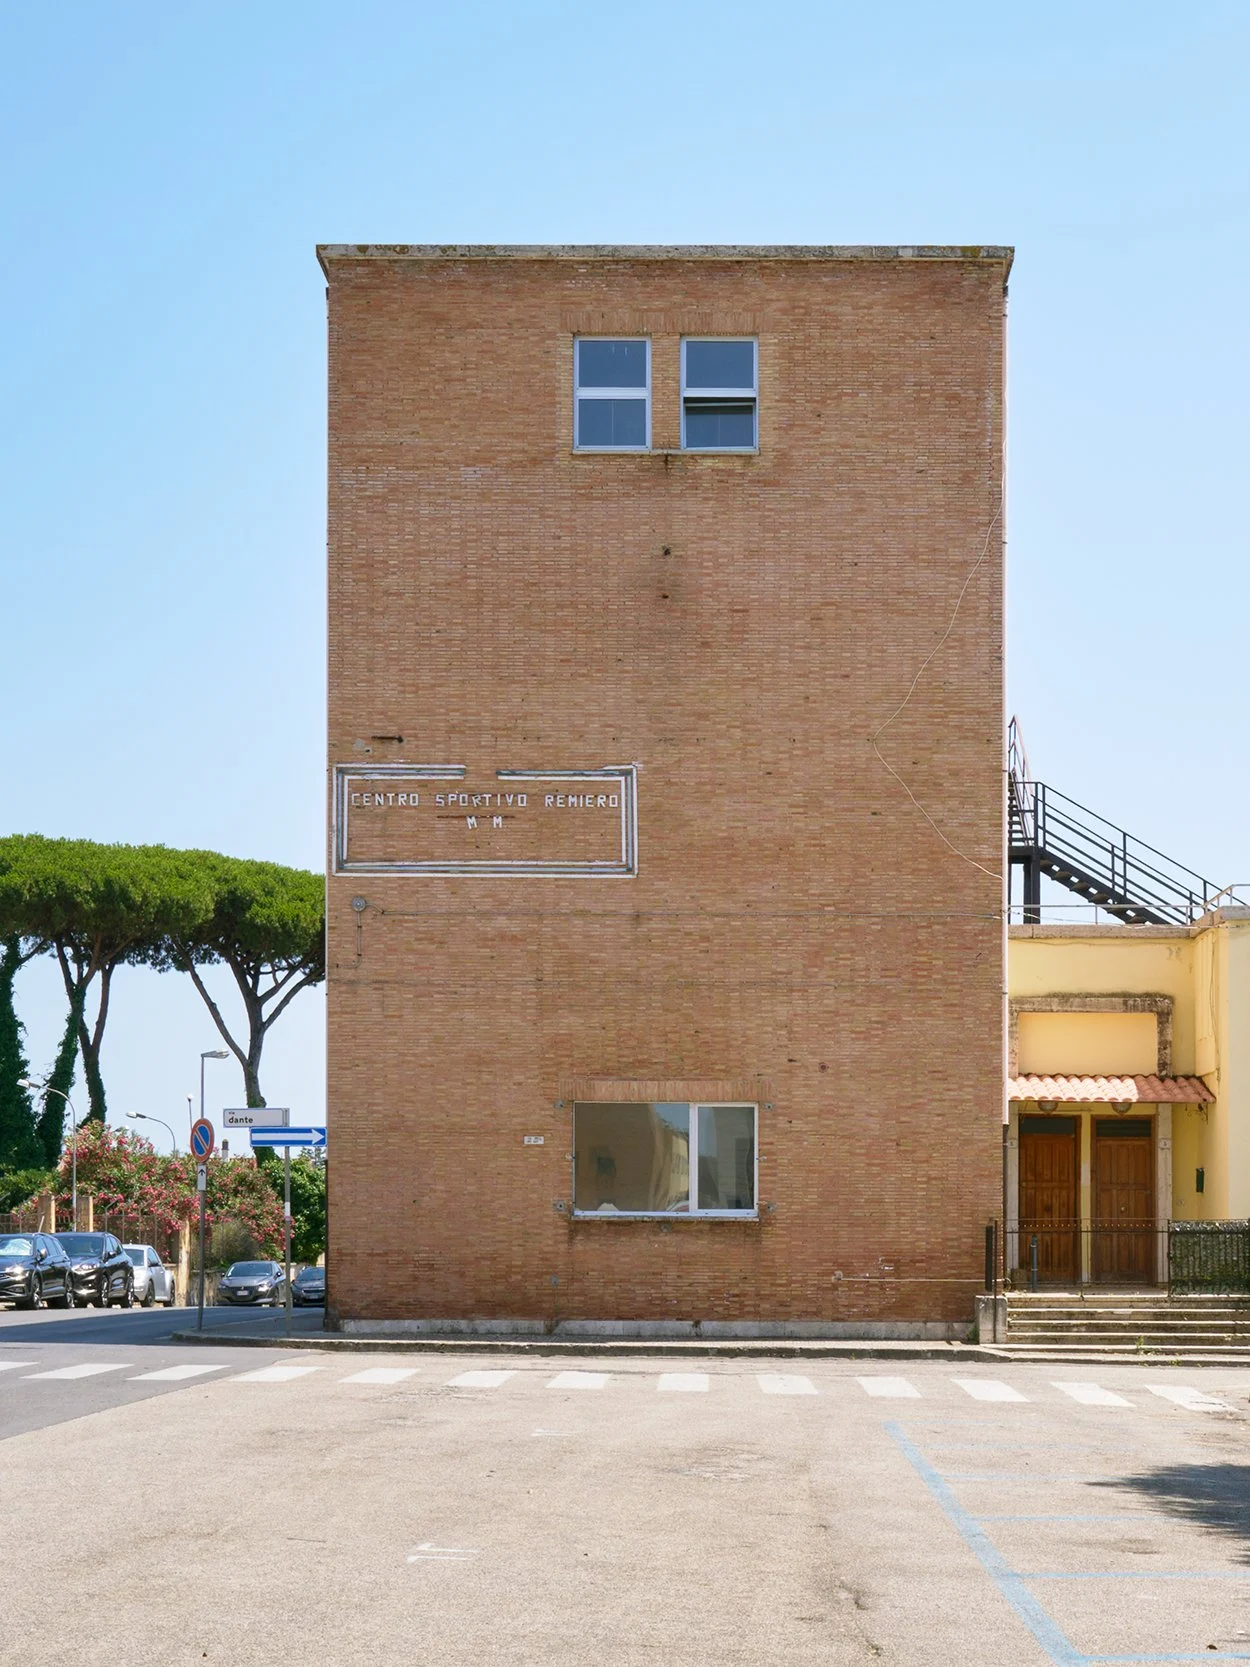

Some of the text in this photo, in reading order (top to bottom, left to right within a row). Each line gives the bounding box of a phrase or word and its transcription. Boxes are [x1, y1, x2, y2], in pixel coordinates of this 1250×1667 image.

[351, 793, 618, 807] CENTRO SPORTIVO REMIERO
[228, 1116, 254, 1124] dante
